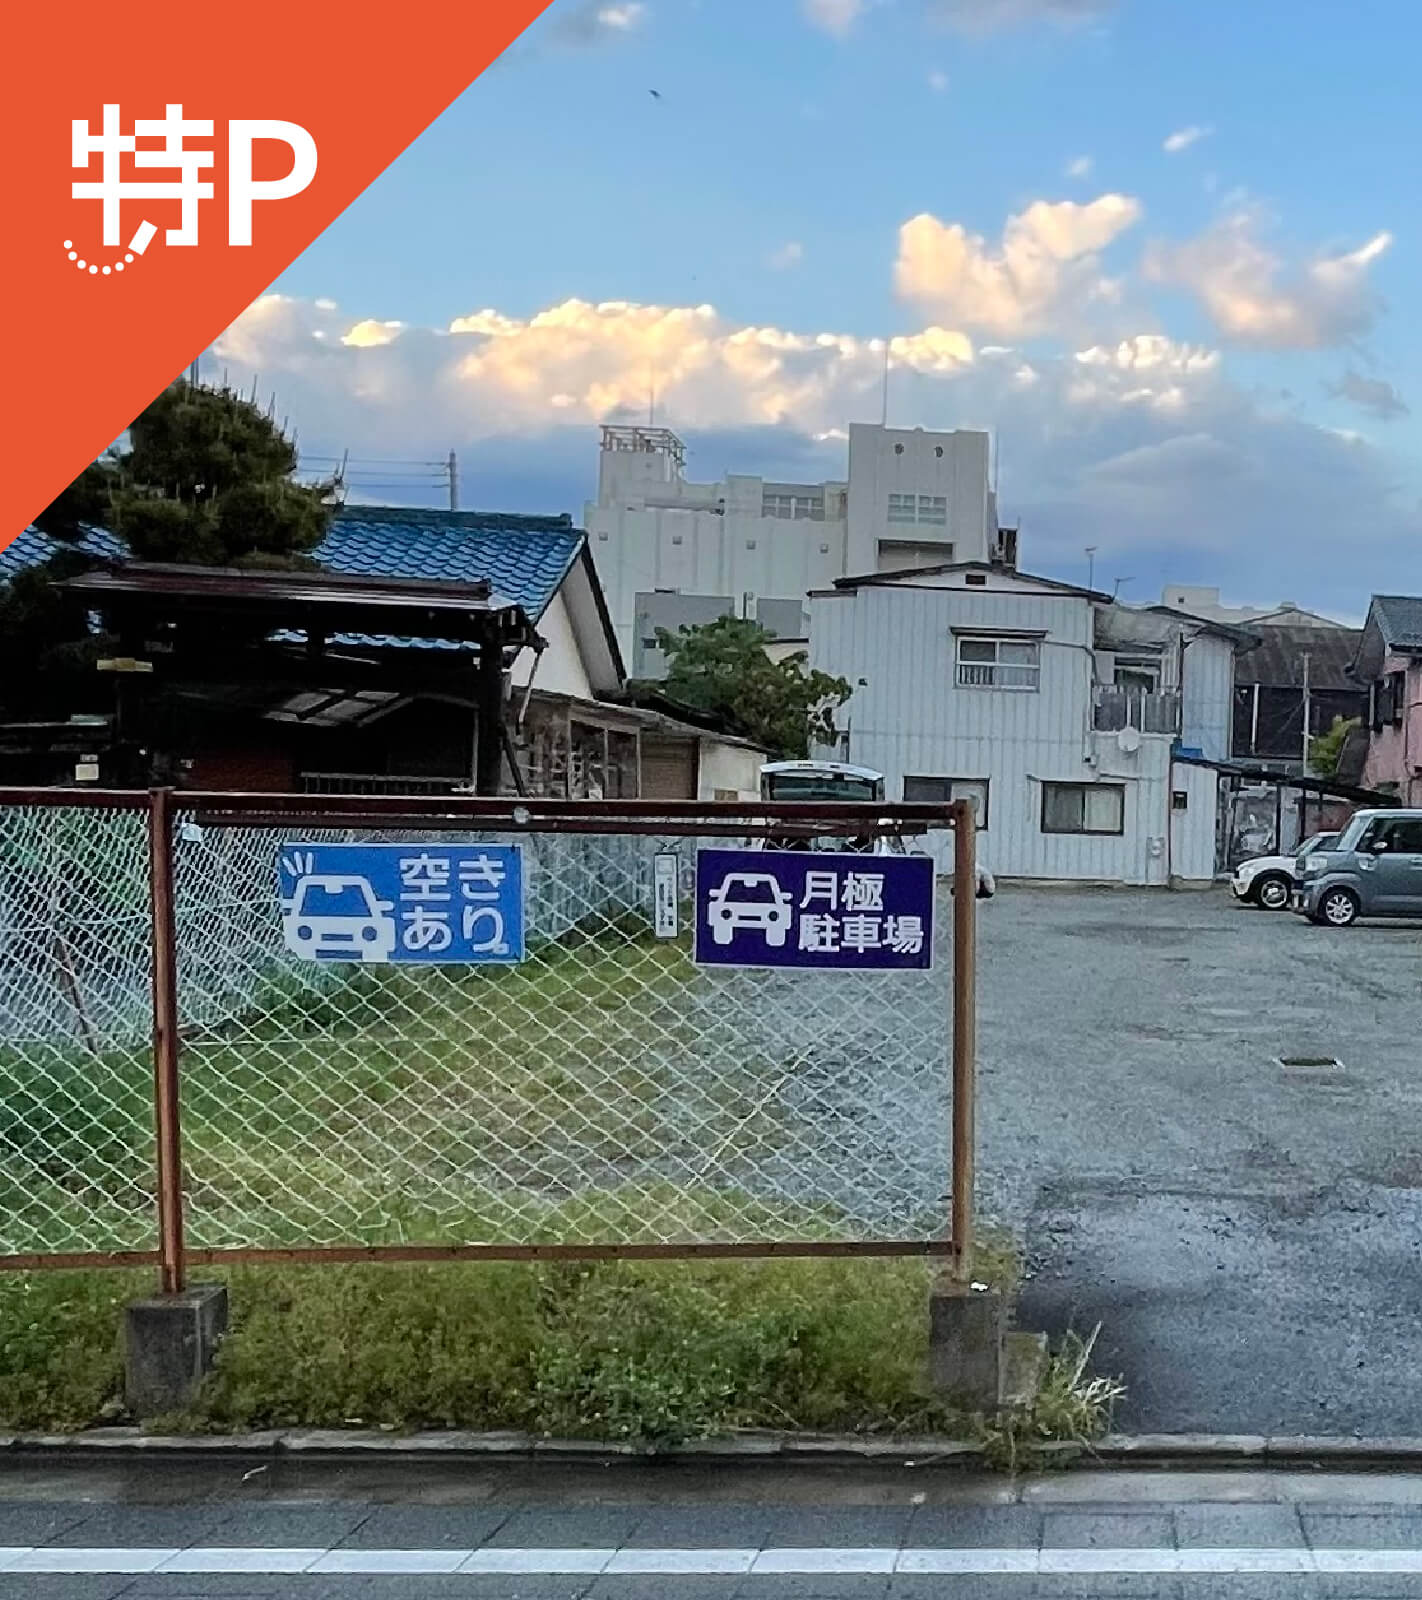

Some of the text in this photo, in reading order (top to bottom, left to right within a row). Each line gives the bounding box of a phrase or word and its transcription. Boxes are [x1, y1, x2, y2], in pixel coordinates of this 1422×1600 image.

[399, 852, 506, 901] 空き
[799, 870, 885, 912] 月極
[798, 912, 924, 954] 駐車場
